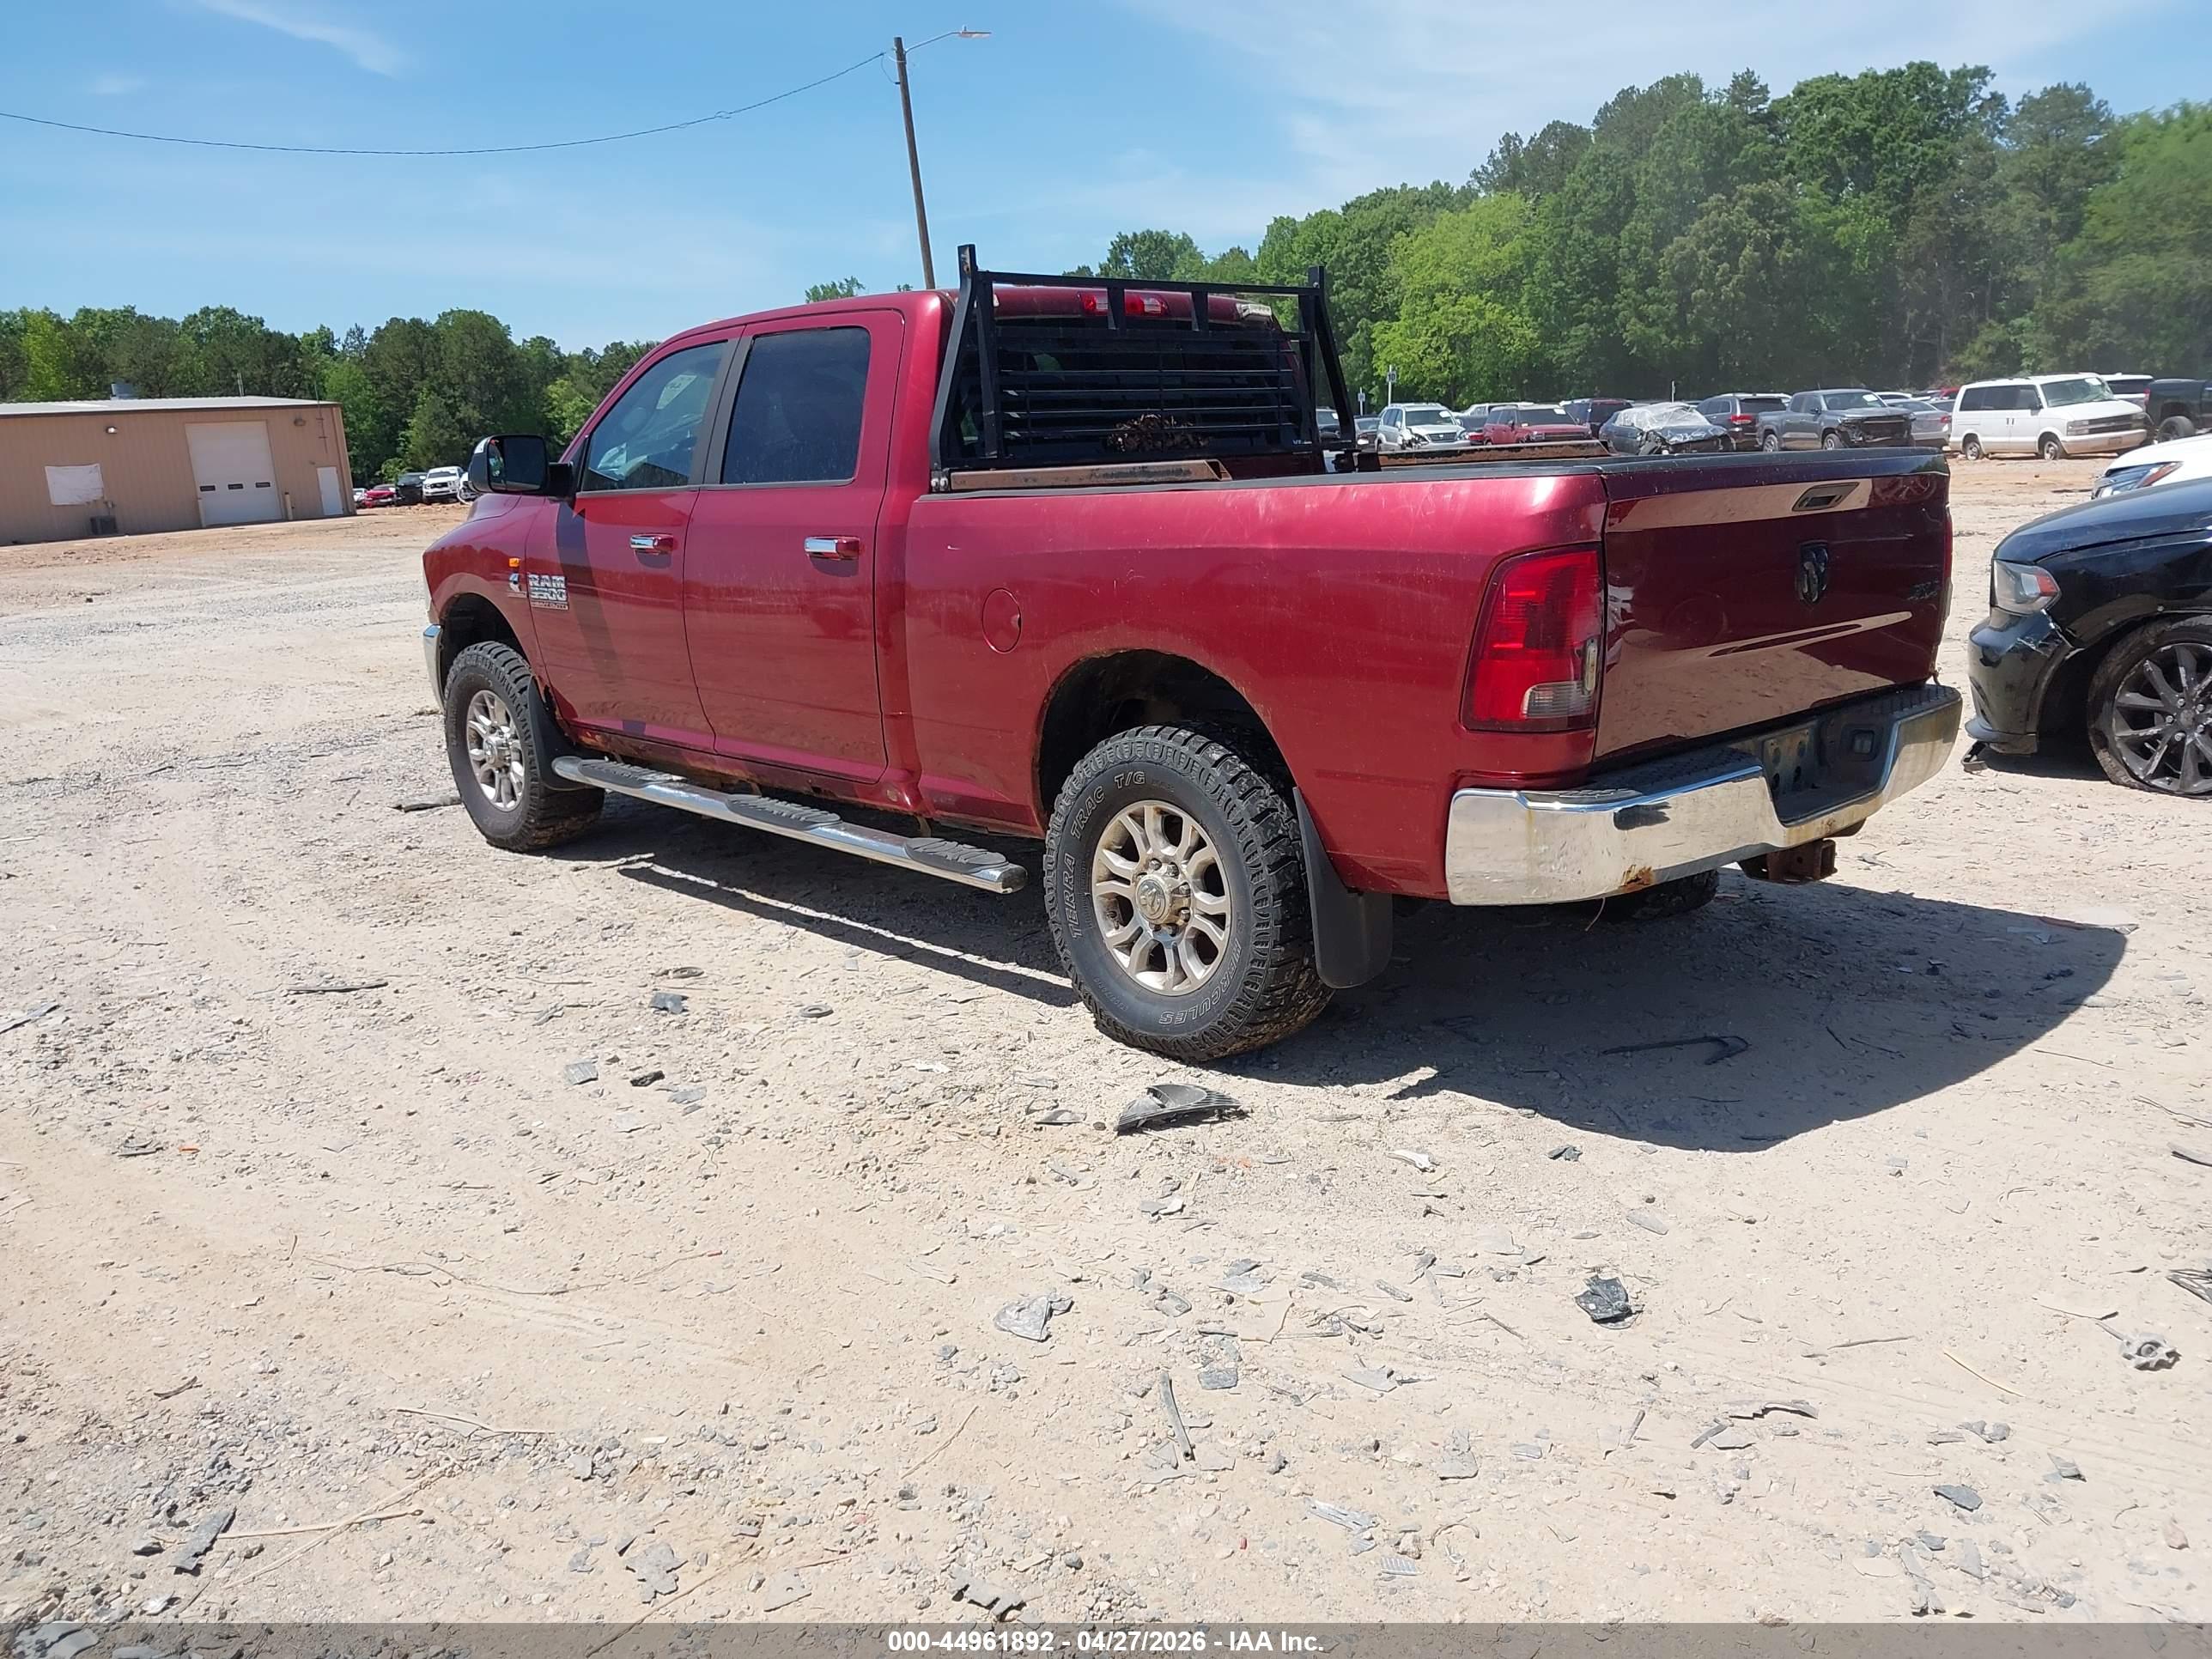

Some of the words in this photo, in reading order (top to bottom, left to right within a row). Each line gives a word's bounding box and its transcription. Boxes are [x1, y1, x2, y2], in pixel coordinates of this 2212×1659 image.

[1388, 373, 1395, 381] 10
[528, 574, 566, 588] RAM
[1115, 771, 1146, 789] T/G
[1071, 786, 1104, 839] TRAC
[1063, 853, 1082, 939] TERRA
[1158, 938, 1242, 1024] HERCULES
